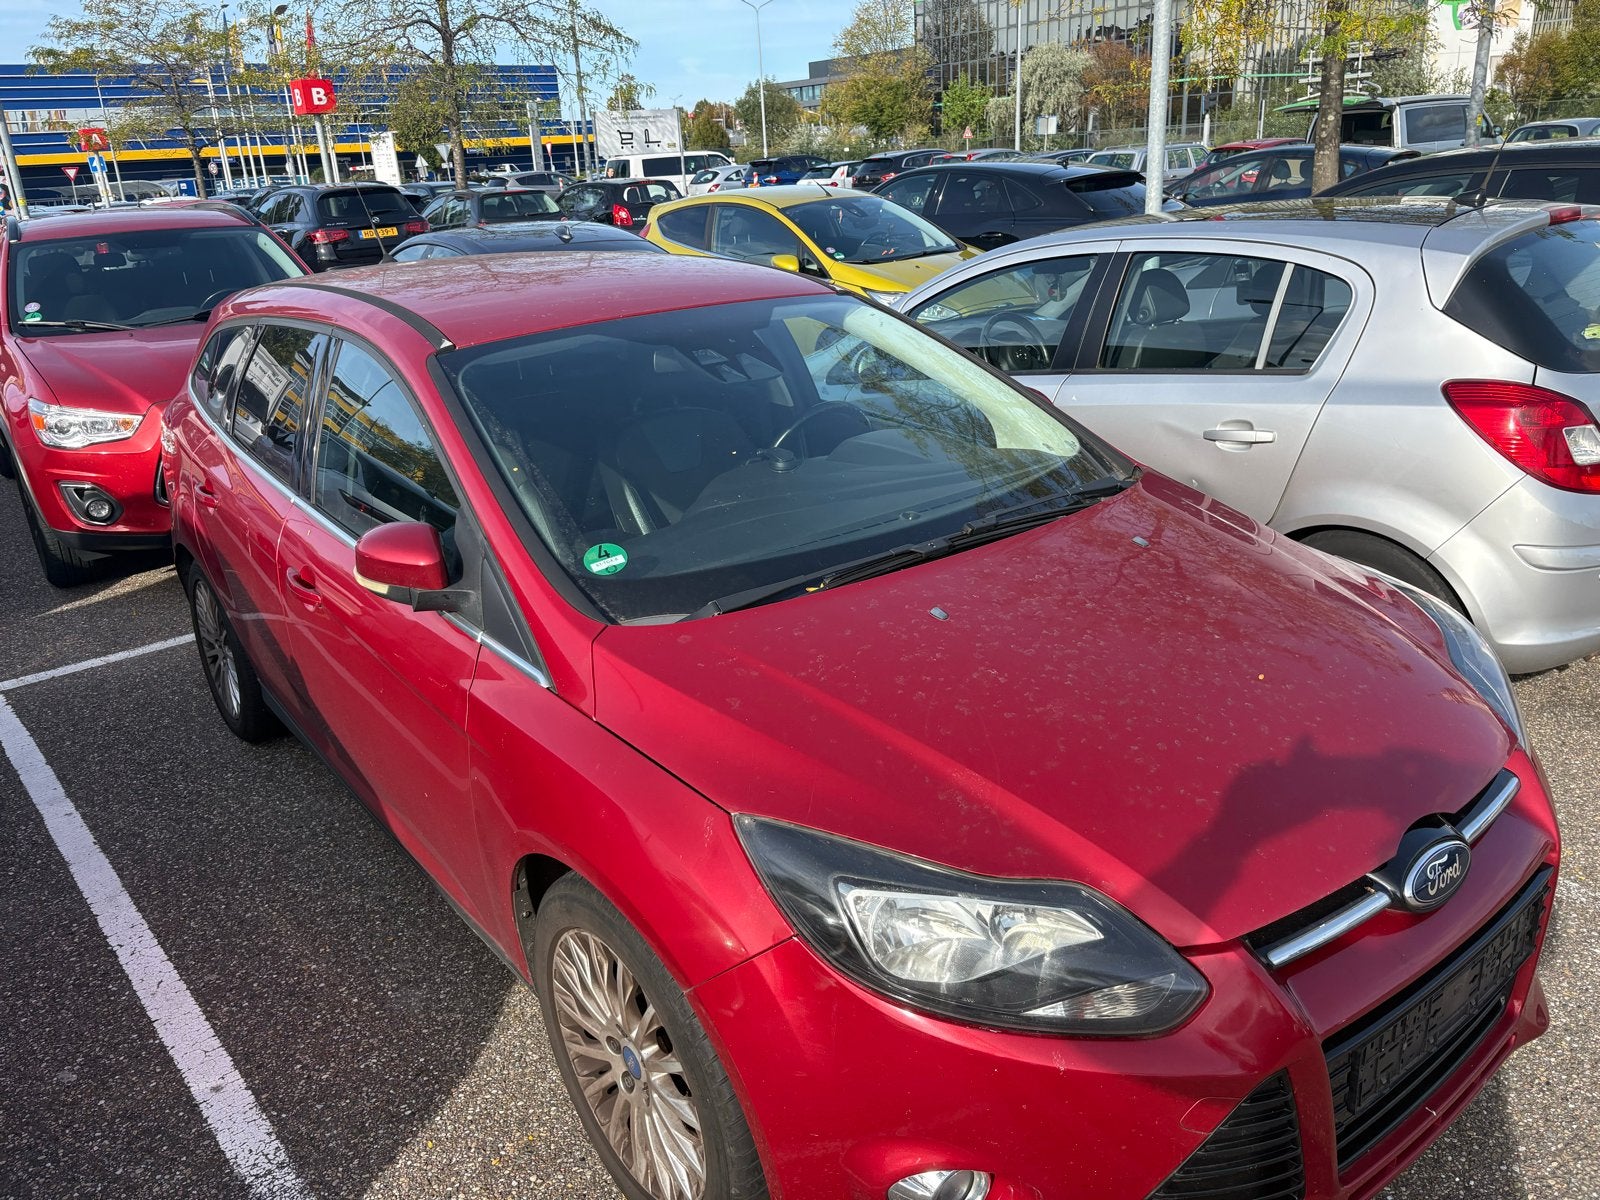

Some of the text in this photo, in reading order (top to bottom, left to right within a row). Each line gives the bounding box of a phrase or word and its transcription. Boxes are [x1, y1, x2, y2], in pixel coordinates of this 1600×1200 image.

[294, 88, 303, 107] B
[311, 87, 328, 106] B
[92, 133, 103, 145] A
[598, 545, 609, 558] 4
[1427, 853, 1462, 896] Ford
